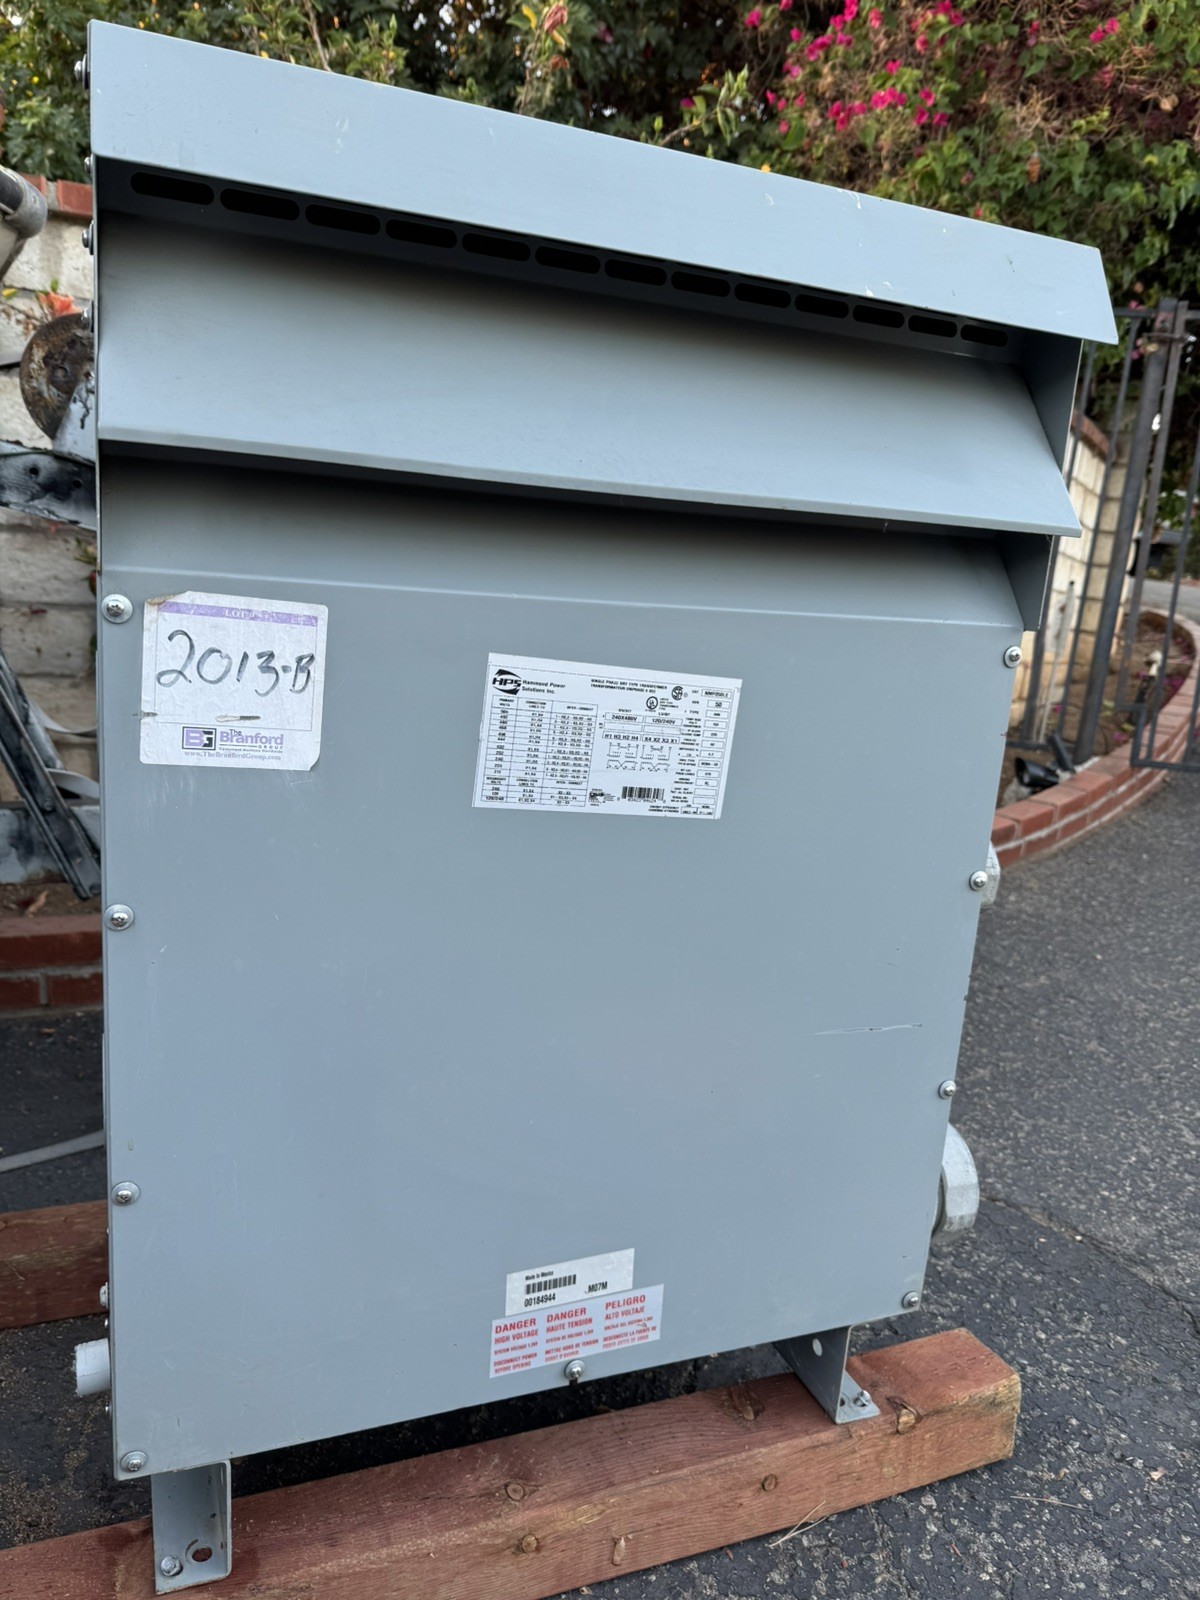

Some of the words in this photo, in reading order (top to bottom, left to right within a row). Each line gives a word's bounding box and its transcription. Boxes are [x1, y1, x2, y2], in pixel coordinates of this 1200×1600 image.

[157, 629, 315, 697] 2013-B
[492, 677, 522, 688] HPS
[219, 731, 284, 746] Branford
[184, 751, 281, 760] www.TheBranfordGroup.com
[588, 1281, 608, 1293] M07M
[524, 1293, 556, 1307] 00184944
[605, 1294, 646, 1310] PELIGRO
[546, 1307, 587, 1323] DANGER
[605, 1311, 619, 1320] ALTO
[621, 1306, 645, 1317] VOLTAJE
[495, 1317, 537, 1334] DANGER
[546, 1323, 566, 1333] HAUTE
[568, 1317, 593, 1328] TENSION
[494, 1335, 510, 1345] HIGH
[511, 1329, 539, 1341] VOLTAGE
[581, 1339, 598, 1347] TENSION
[510, 1344, 527, 1352] VOLTAGE
[494, 1356, 521, 1367] DISCONNECT
[521, 1352, 537, 1360] POWER
[494, 1366, 511, 1374] BEFORE
[512, 1361, 532, 1370] OPENING
